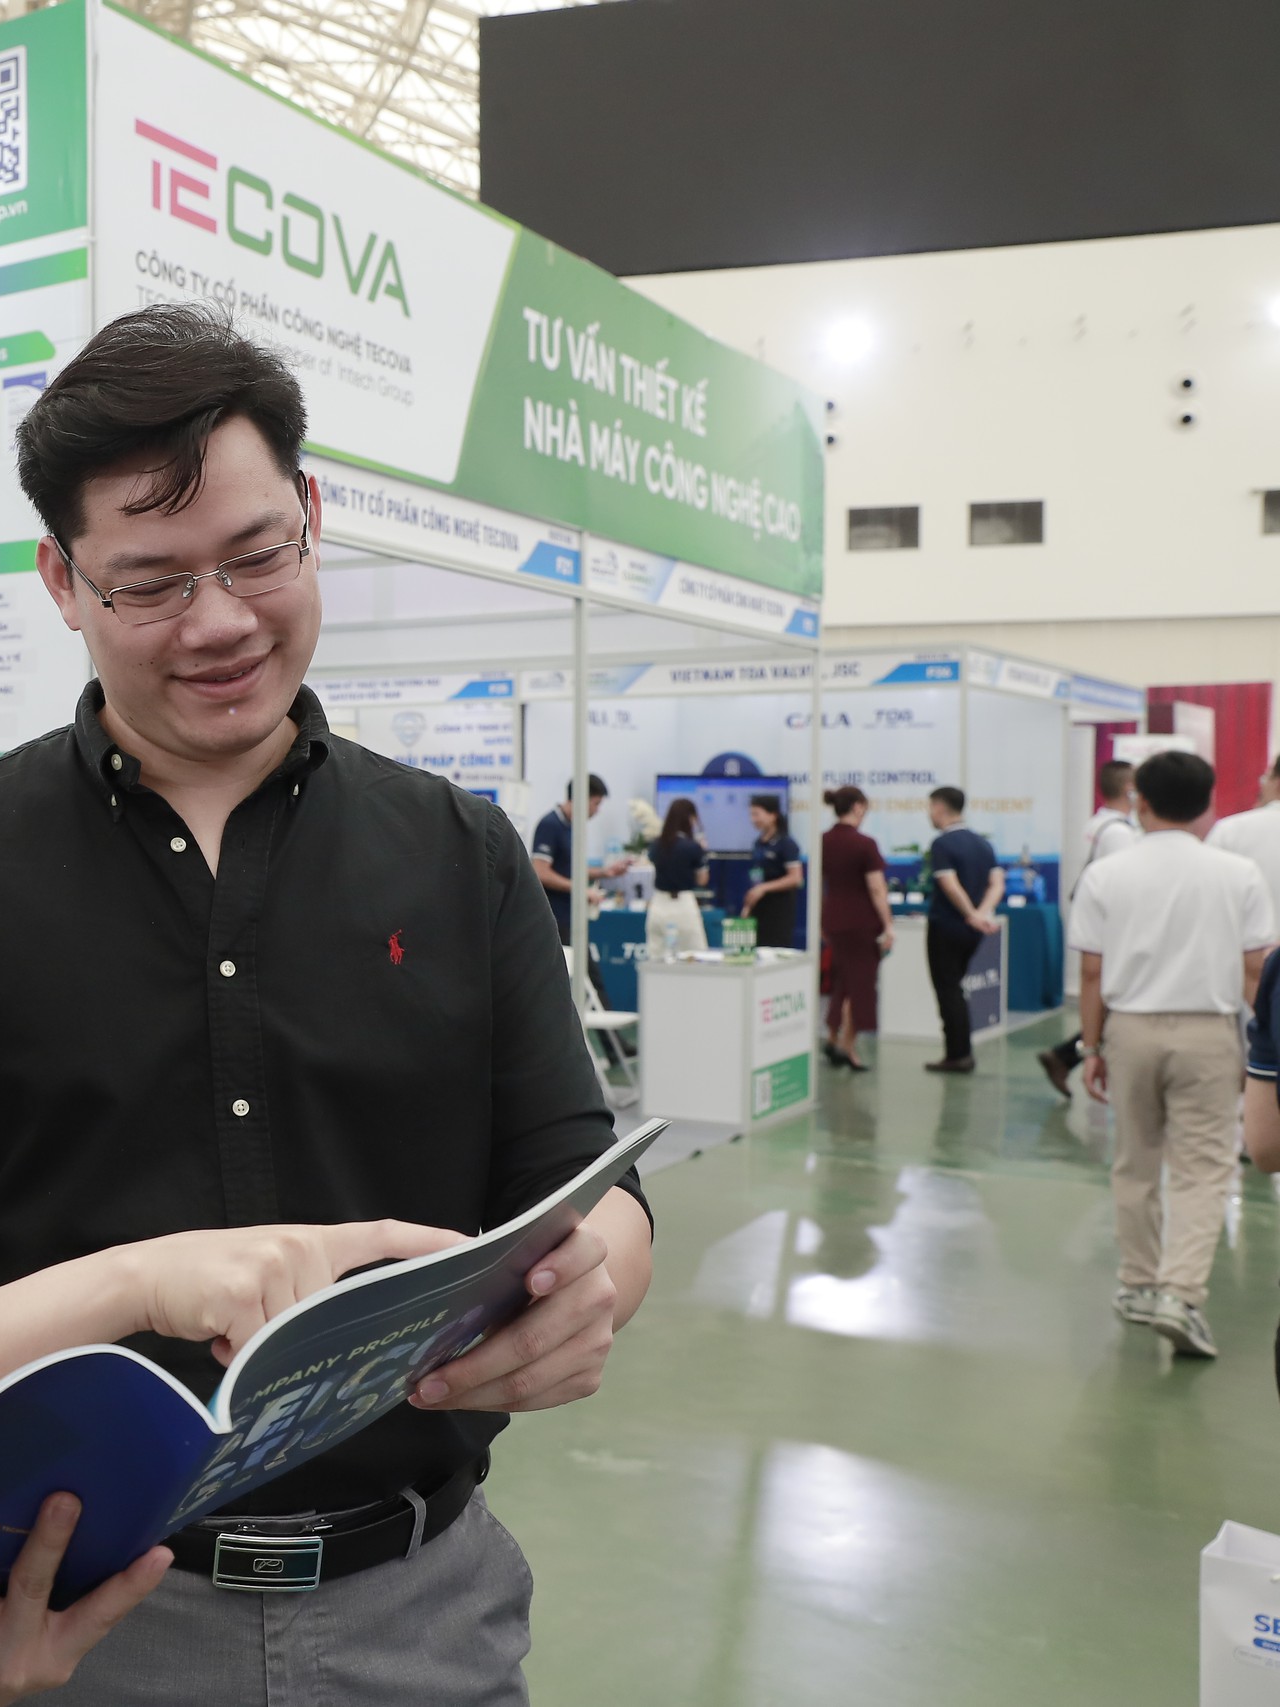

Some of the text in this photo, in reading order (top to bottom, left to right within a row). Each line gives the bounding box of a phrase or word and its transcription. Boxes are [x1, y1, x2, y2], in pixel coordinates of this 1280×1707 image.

[135, 118, 411, 319] TECOVA
[135, 249, 186, 288] CÔNG
[189, 271, 211, 297] TY
[239, 289, 279, 325] PHẦN
[281, 302, 324, 343] CÔNG
[326, 324, 363, 361] NGHỆ
[365, 340, 412, 375] TECOVA
[523, 306, 709, 437] TƯ VẤN THIẾT KẾ
[319, 475, 348, 508] ÔNG
[523, 395, 801, 543] NHÀ MÁY CÔNG NGHỆ CAO
[670, 668, 735, 683] VIETNAM
[234, 1308, 449, 1414] OMPANY PROFILE
